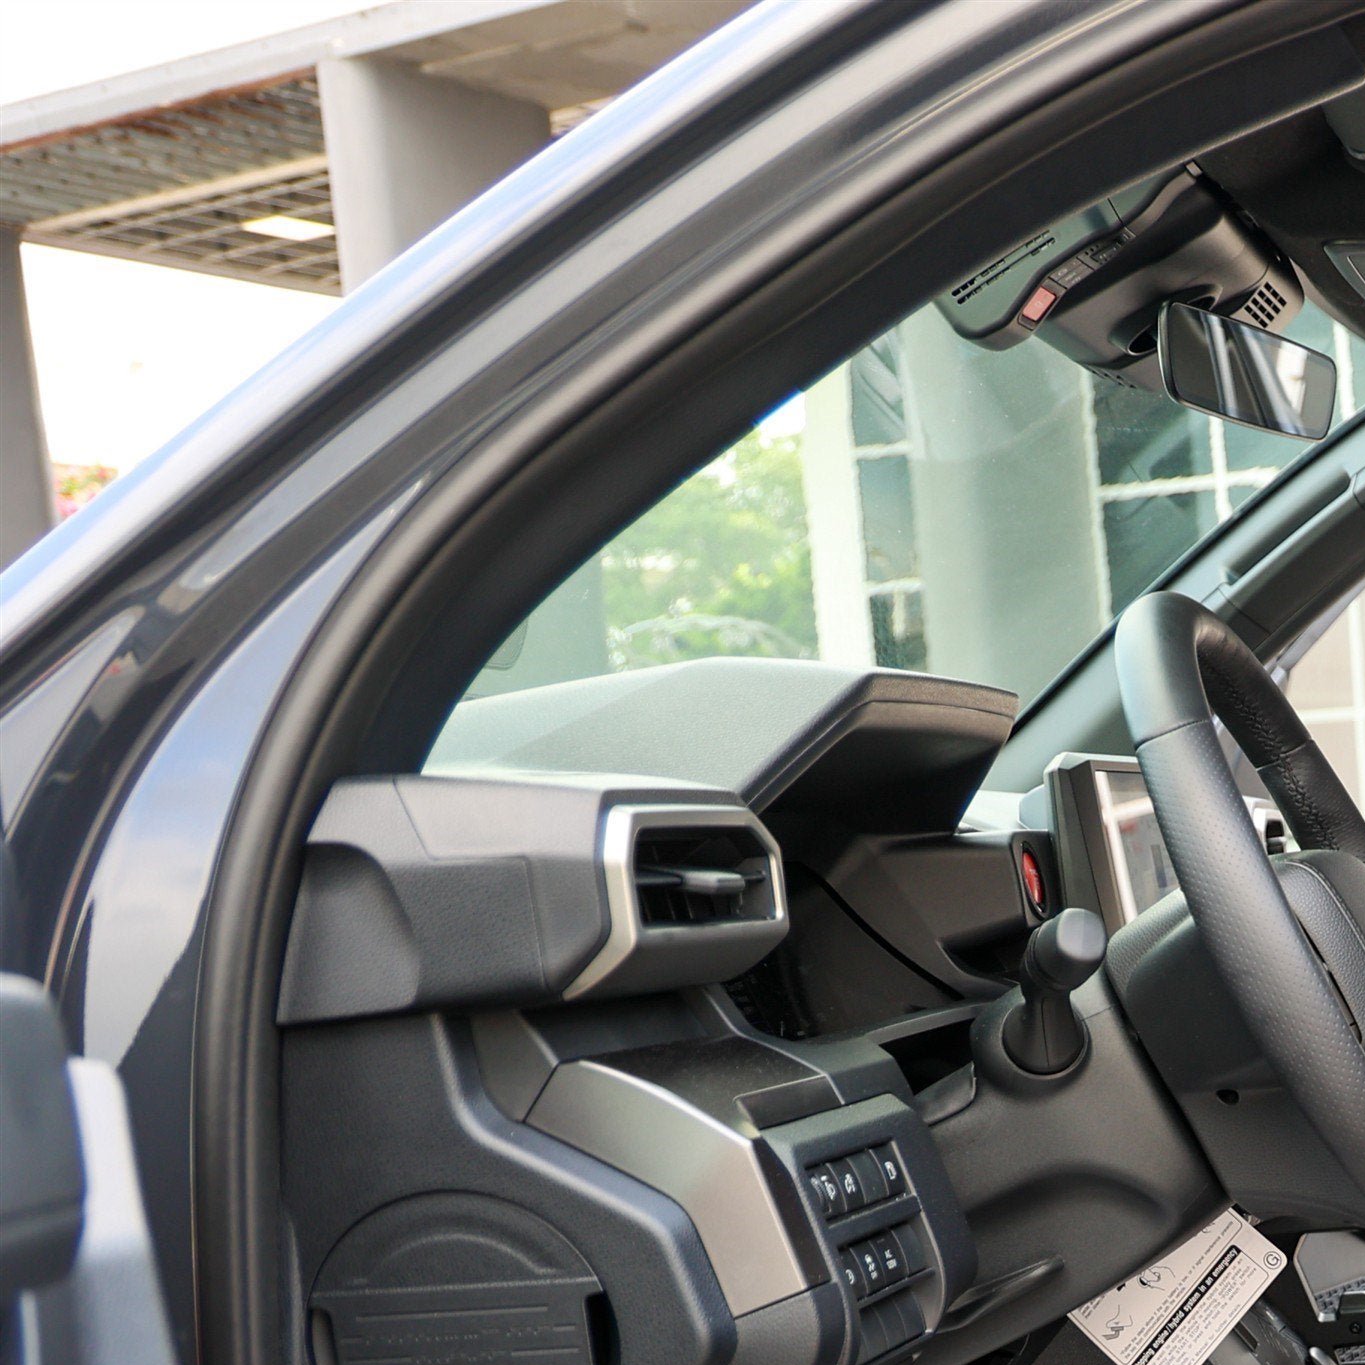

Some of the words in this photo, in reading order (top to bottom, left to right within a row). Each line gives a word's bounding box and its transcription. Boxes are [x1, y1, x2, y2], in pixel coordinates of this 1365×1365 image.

[1181, 1290, 1201, 1312] system
[1197, 1283, 1207, 1293] in
[1203, 1275, 1214, 1286] an
[1210, 1246, 1237, 1277] emergency
